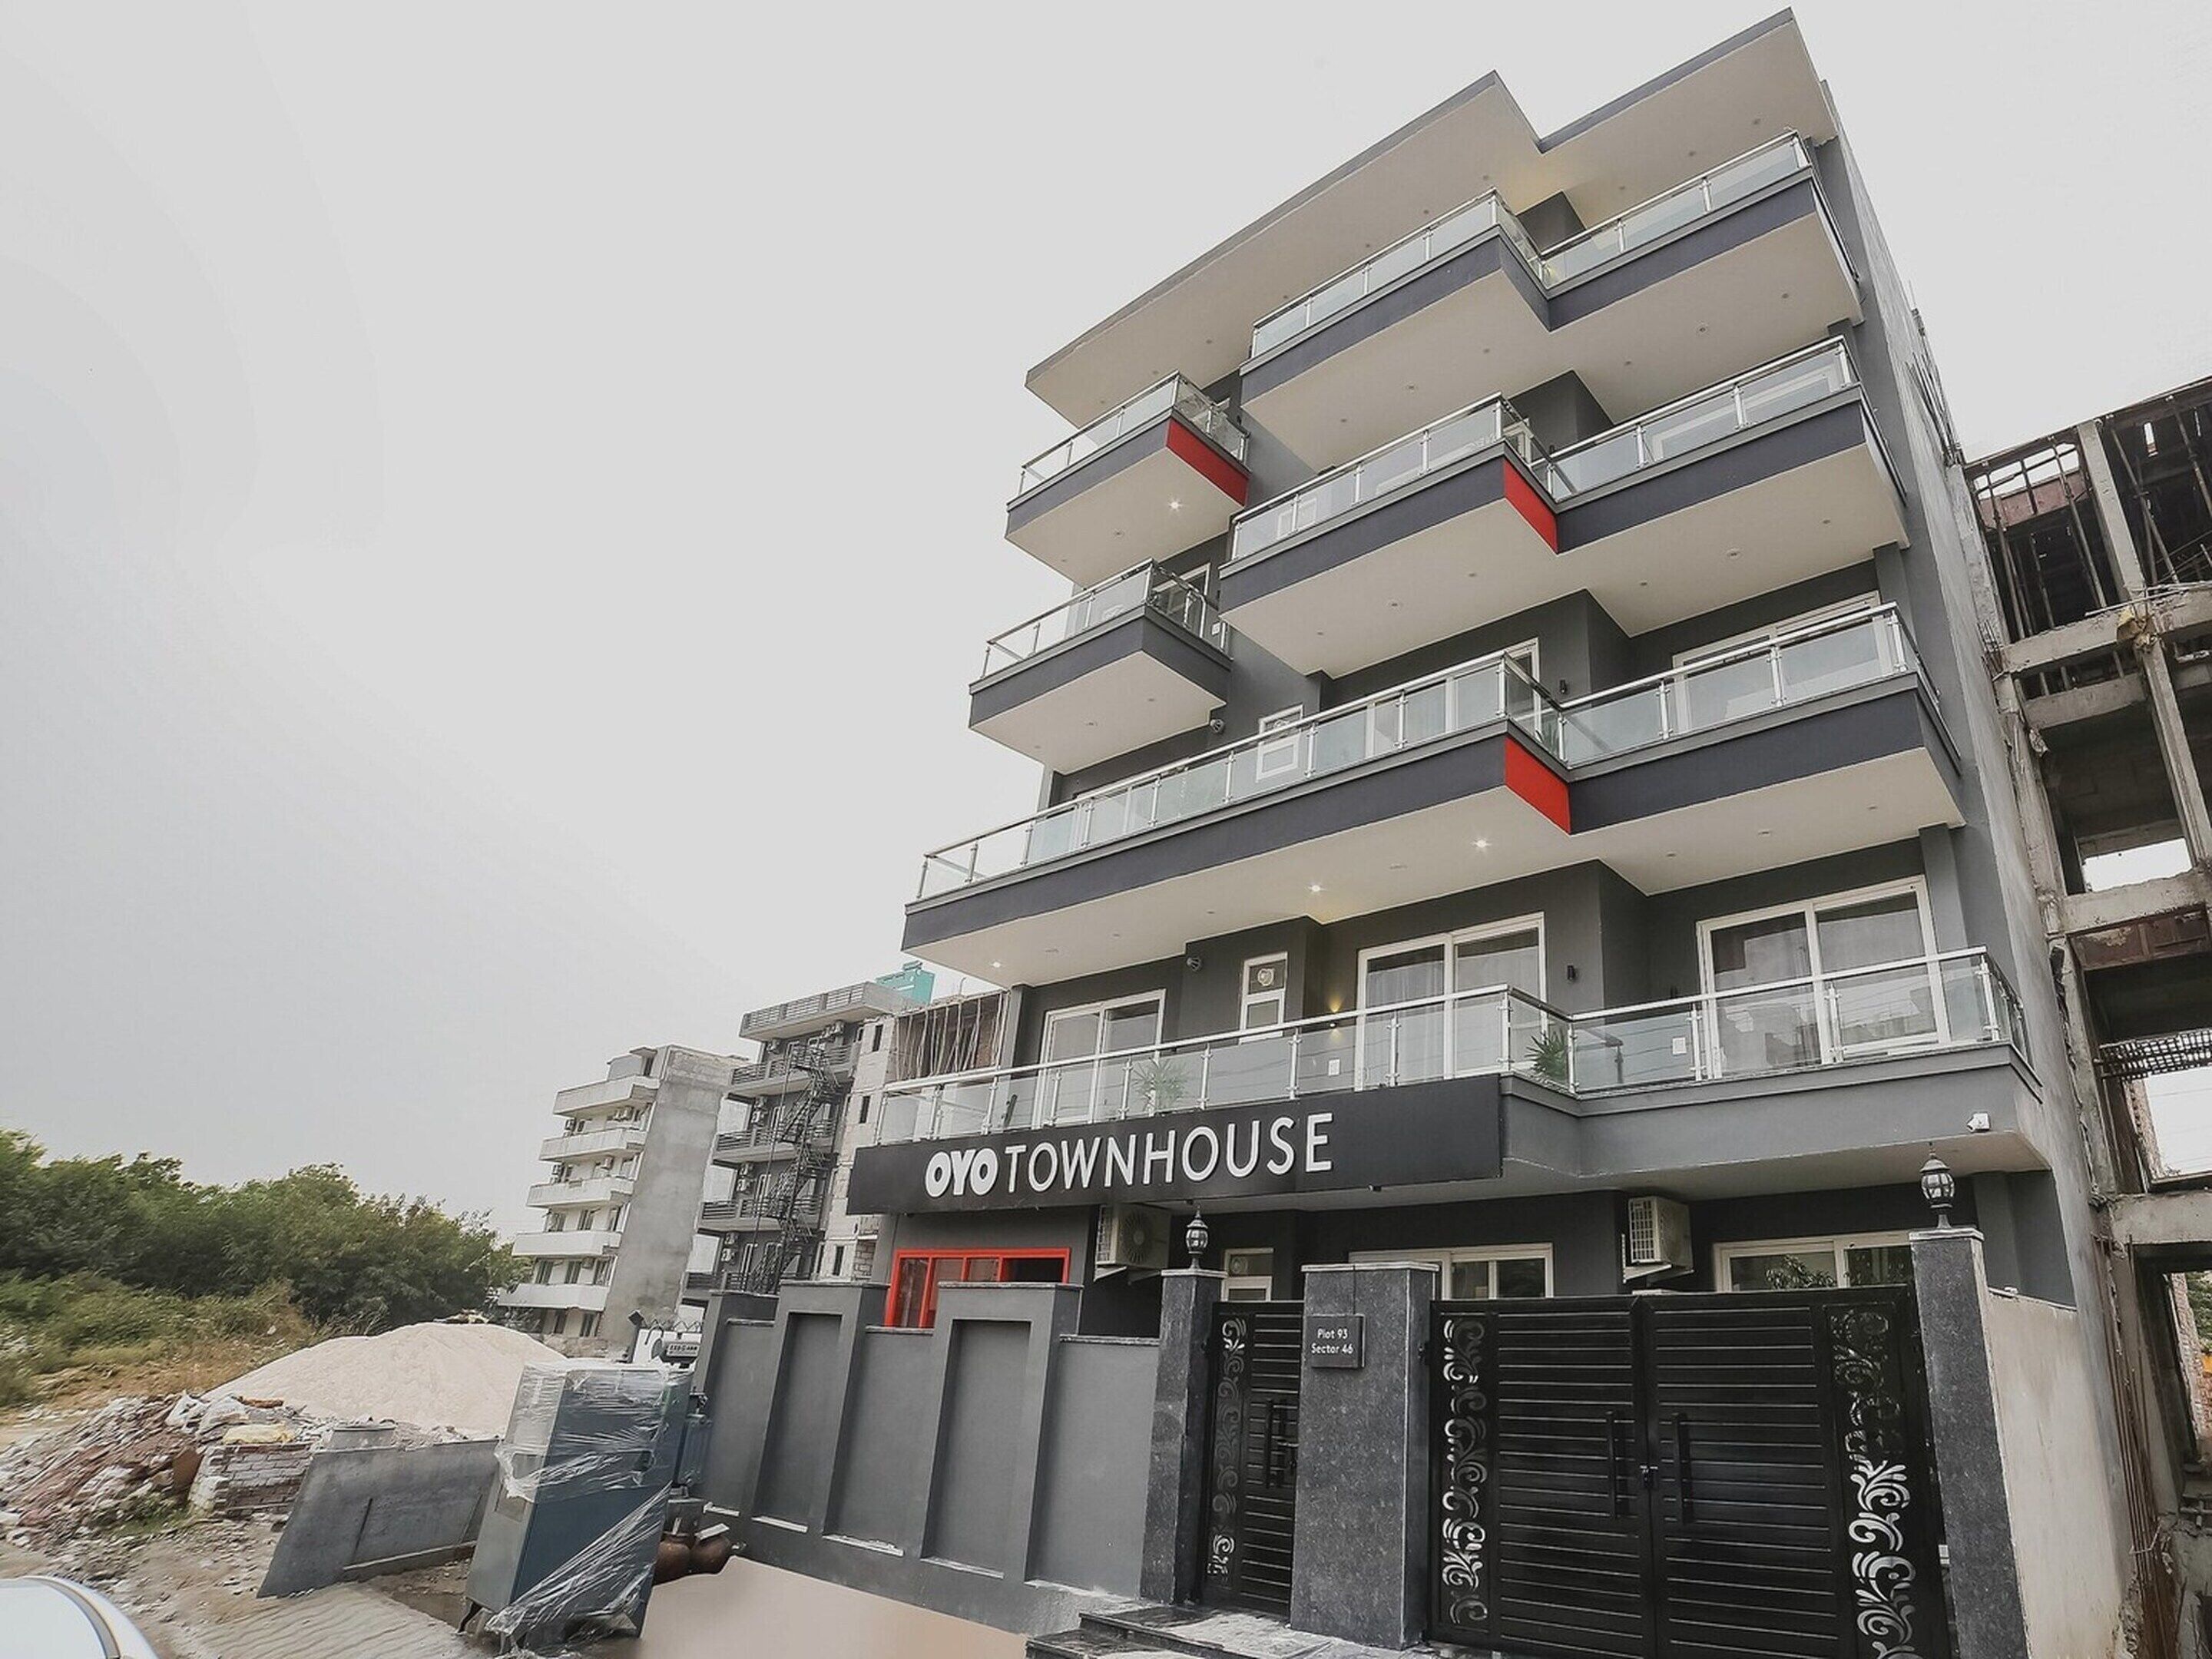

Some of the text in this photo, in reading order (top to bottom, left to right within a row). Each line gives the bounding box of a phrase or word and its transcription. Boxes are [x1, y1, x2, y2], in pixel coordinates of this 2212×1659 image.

[924, 1112, 1333, 1197] OYO TOWNHOUSE
[1317, 1328, 1348, 1339] Plot 93
[1311, 1343, 1354, 1354] Sector 46
